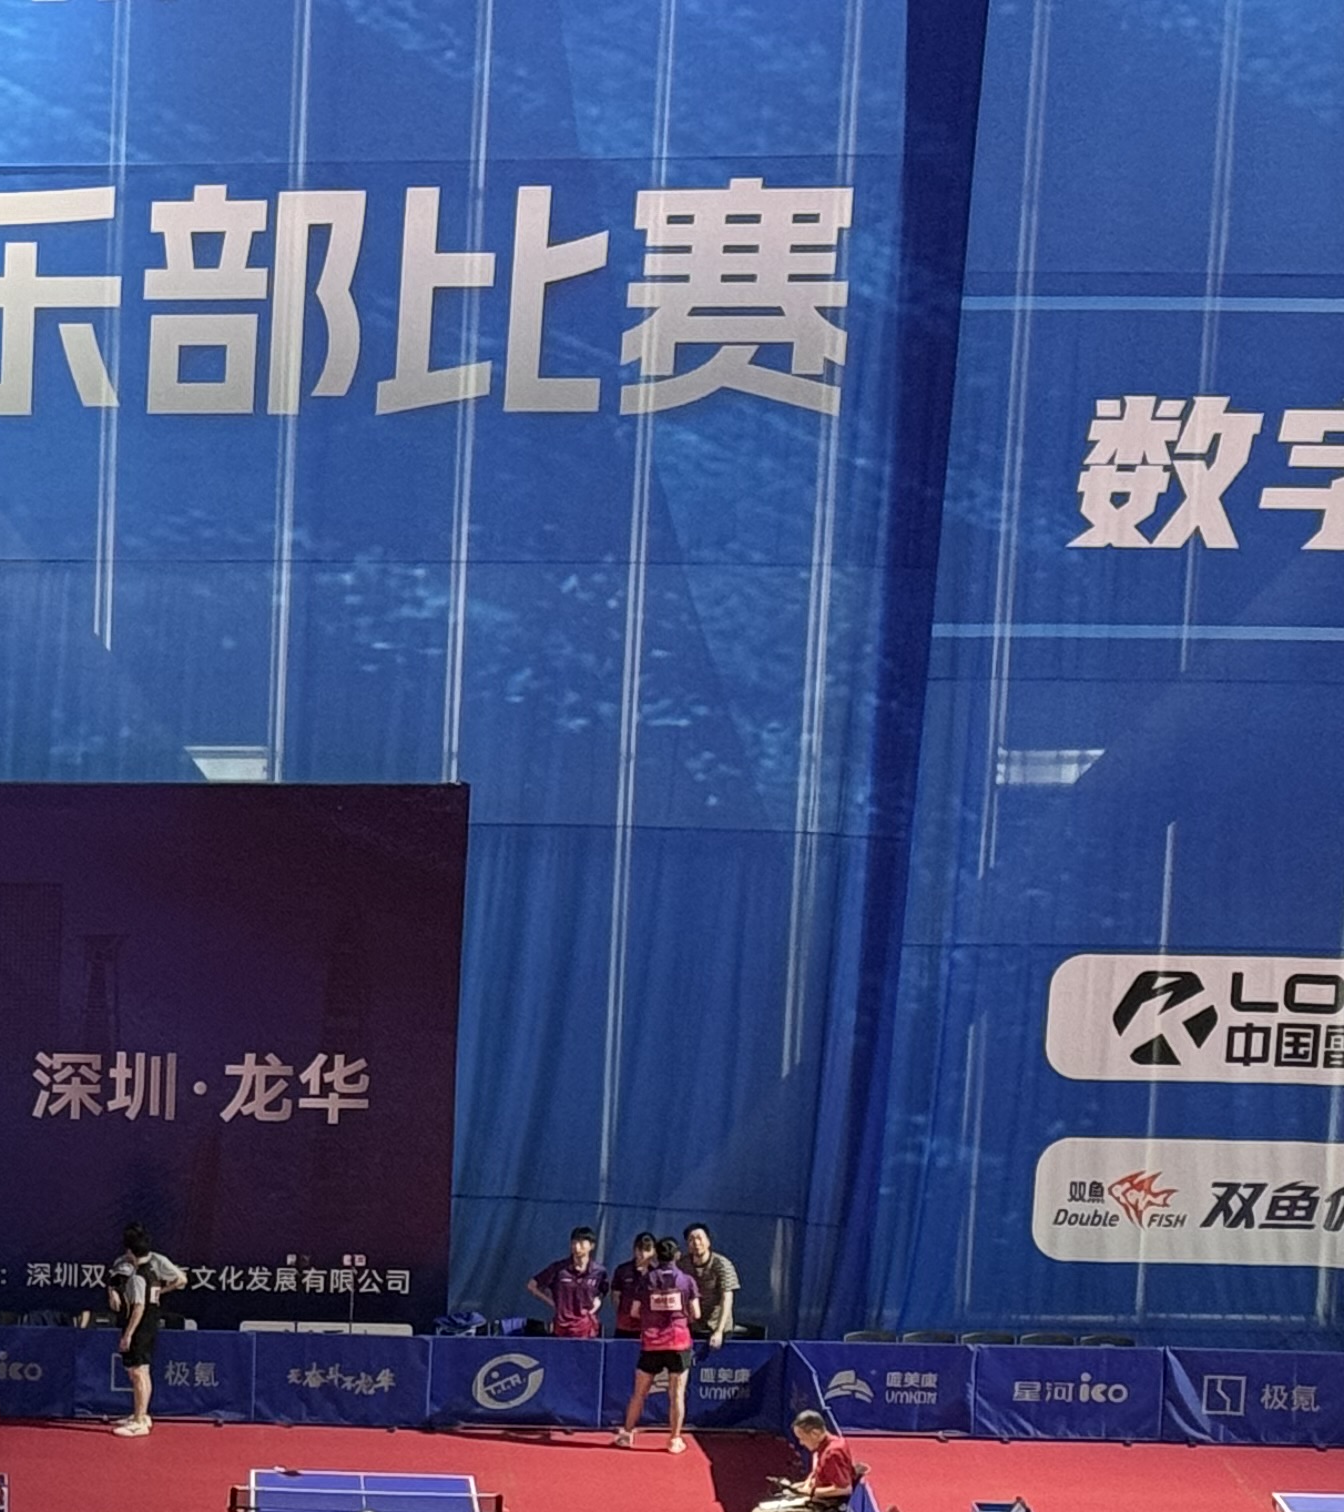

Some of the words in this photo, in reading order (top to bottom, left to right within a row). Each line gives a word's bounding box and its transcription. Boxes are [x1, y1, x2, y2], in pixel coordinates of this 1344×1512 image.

[31, 1051, 372, 1126] 深圳·龙华
[1068, 1180, 1106, 1203] 双鱼
[1053, 1207, 1120, 1228] Double
[1148, 1213, 1188, 1229] FISH
[164, 1359, 220, 1388] 极氪
[1260, 1383, 1321, 1413] 极氪
